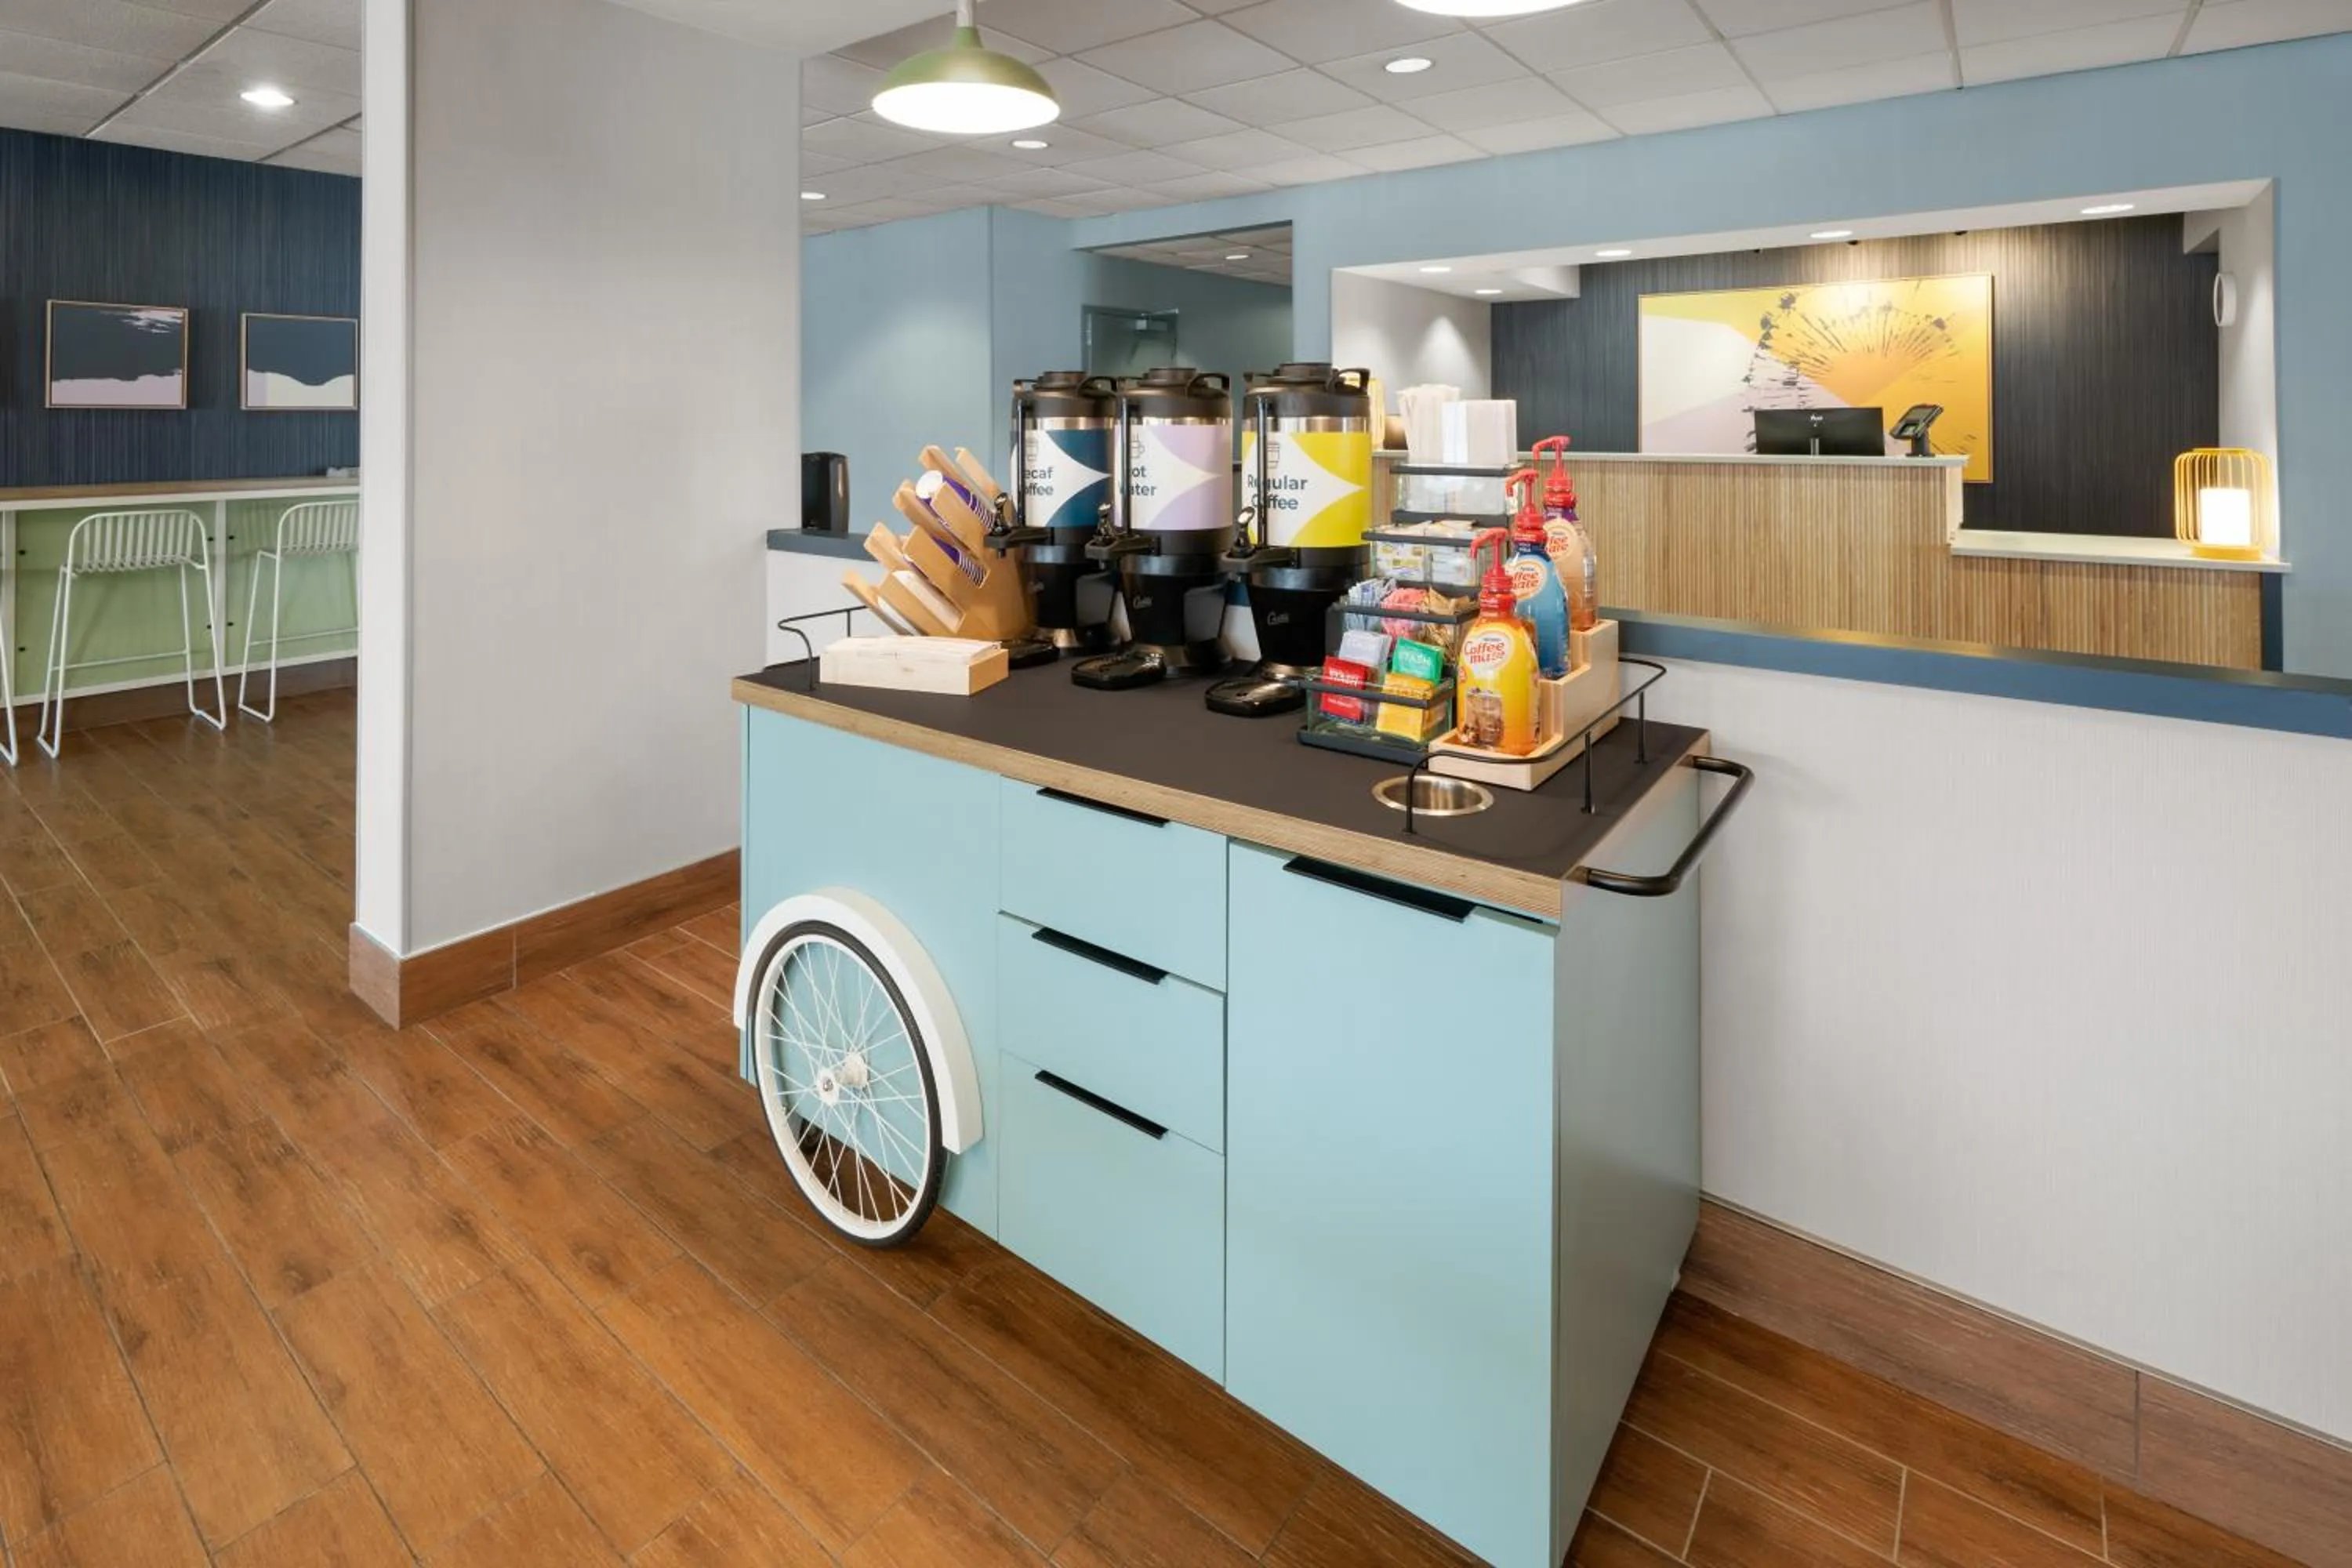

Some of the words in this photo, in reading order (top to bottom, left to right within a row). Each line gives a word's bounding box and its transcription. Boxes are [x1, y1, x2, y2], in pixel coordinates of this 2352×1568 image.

[1023, 467, 1054, 479] ecaf
[1024, 483, 1054, 495] offee
[1251, 493, 1298, 510] Cffee
[1464, 641, 1505, 655] Coffee
